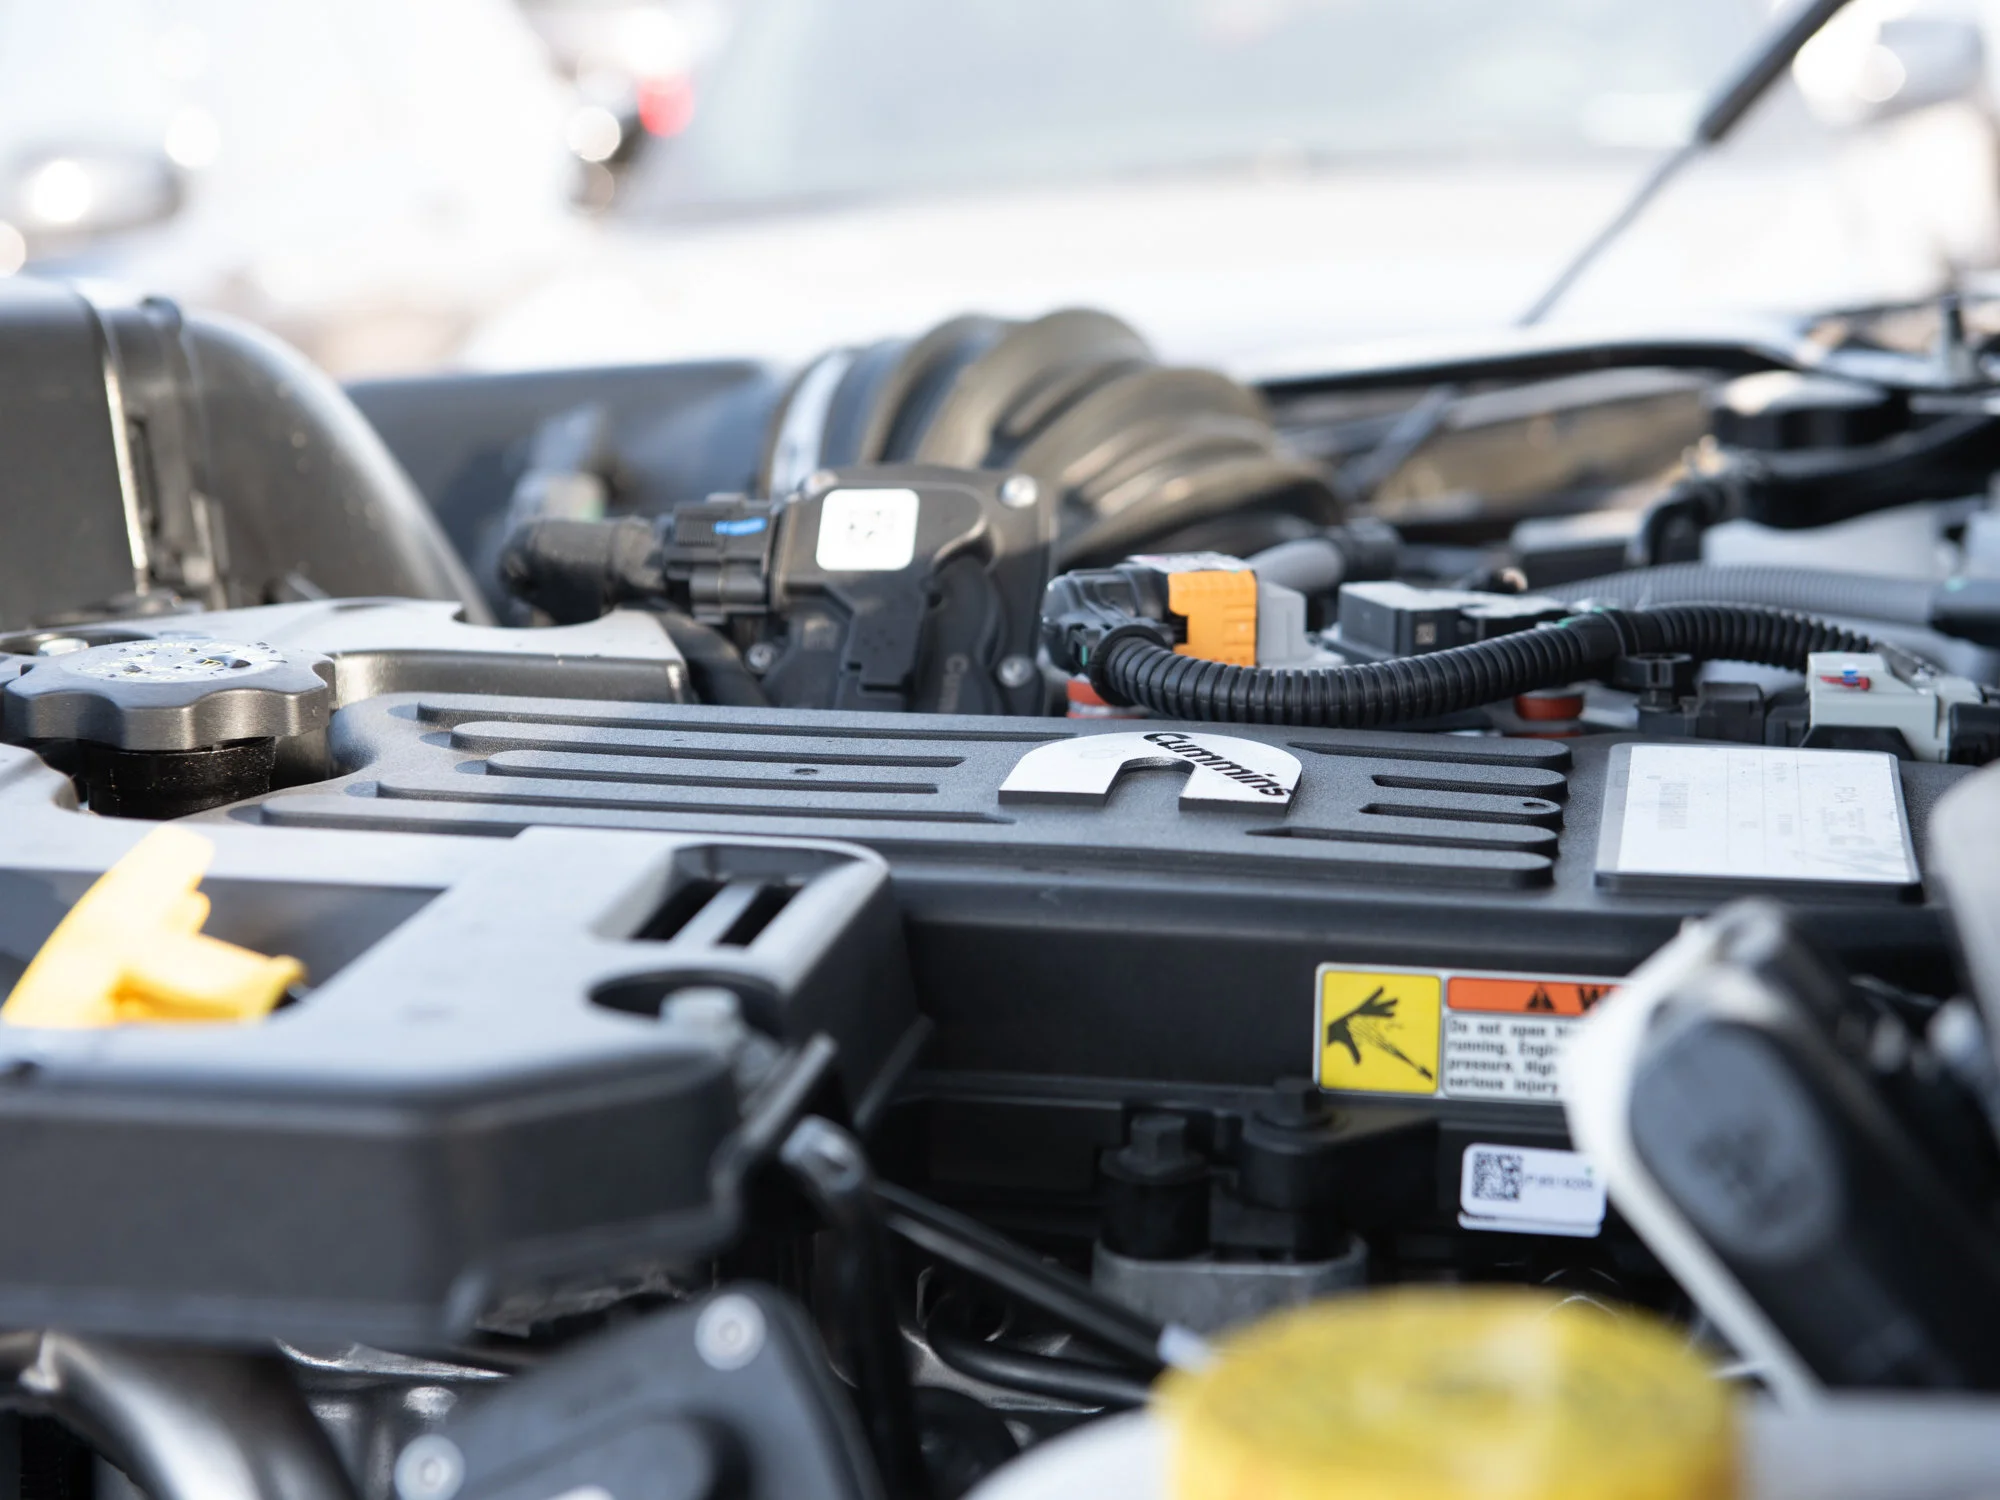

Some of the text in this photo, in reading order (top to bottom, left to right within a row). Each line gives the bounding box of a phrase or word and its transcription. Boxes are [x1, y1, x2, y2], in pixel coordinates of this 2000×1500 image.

[1143, 732, 1288, 797] Cummins
[1450, 1020, 1468, 1033] Do
[1477, 1024, 1502, 1035] not
[1510, 1026, 1546, 1040] open
[1449, 1078, 1558, 1096] serious injury
